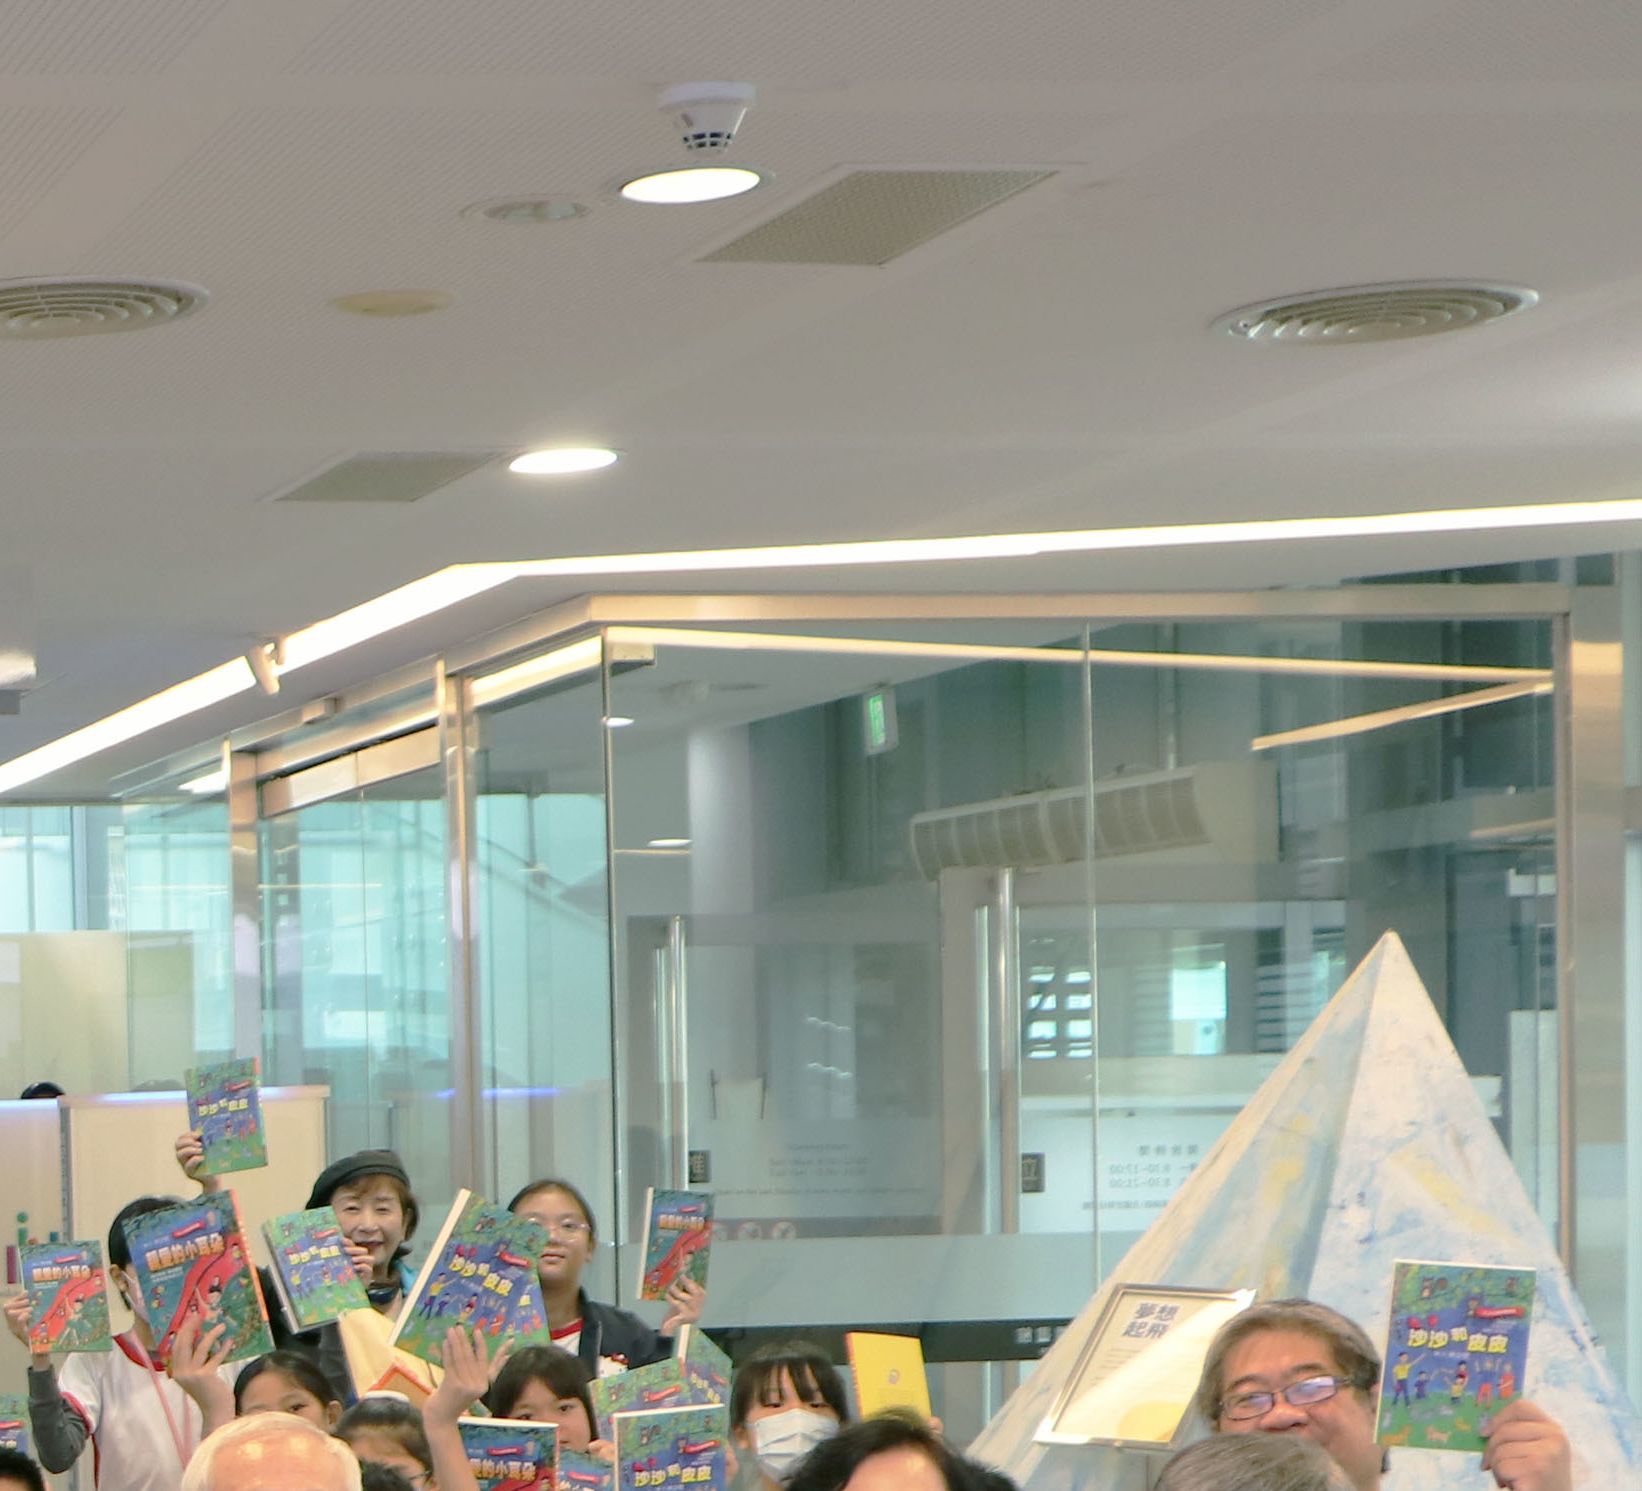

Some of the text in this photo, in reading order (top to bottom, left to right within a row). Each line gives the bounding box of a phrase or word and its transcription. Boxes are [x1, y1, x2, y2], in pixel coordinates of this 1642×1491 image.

[1135, 1302, 1179, 1321] 夢想
[1122, 1320, 1169, 1339] 起飛
[1407, 1326, 1509, 1353] 沙沙和皮皮
